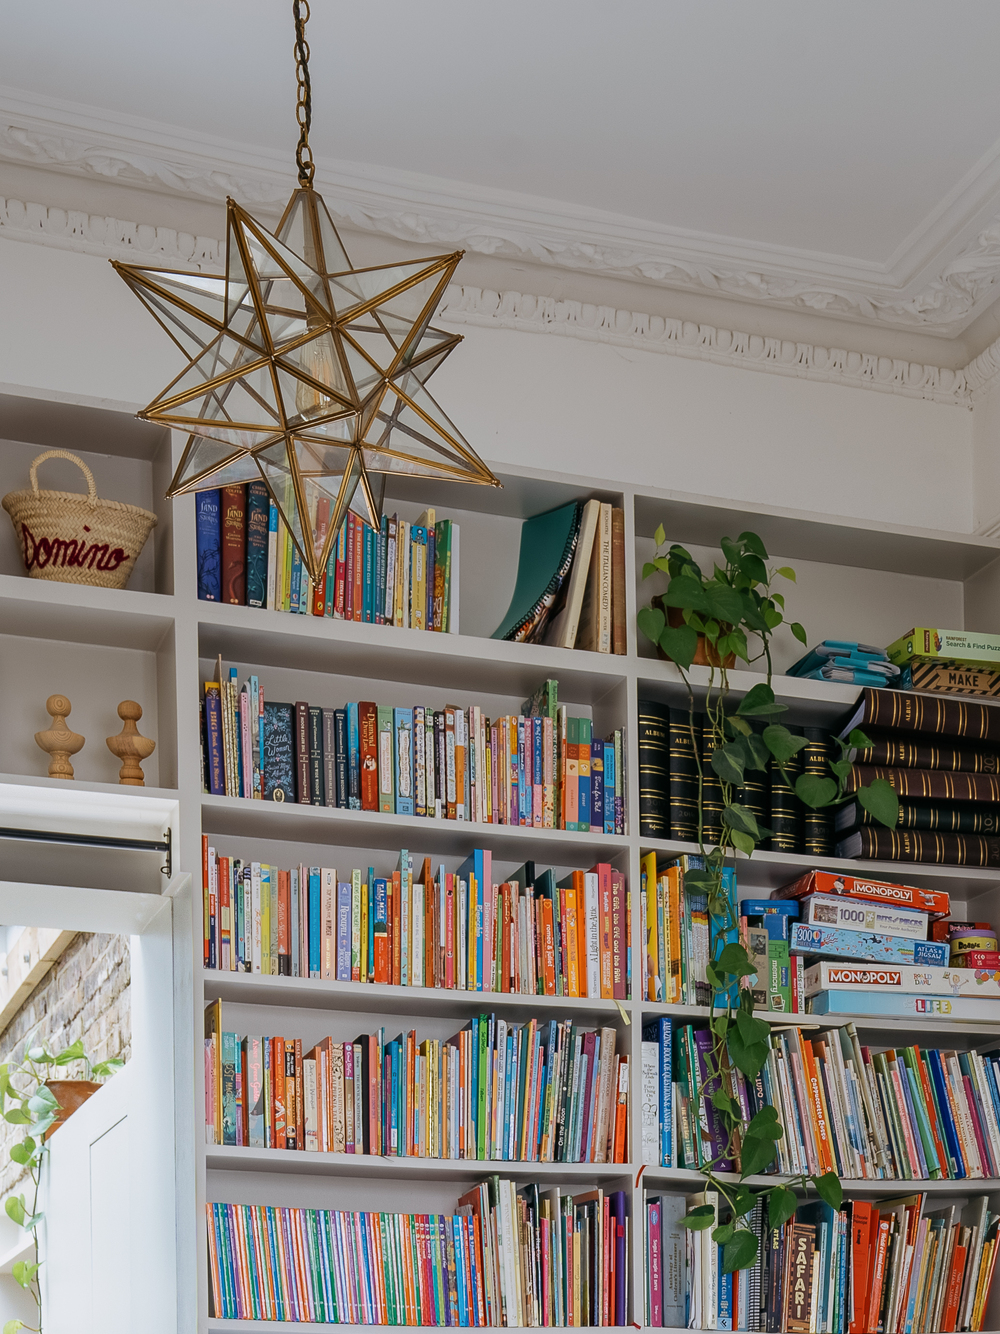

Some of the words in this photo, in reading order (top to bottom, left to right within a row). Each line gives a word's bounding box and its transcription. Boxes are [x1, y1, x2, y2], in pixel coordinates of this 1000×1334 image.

[22, 523, 129, 571] Domino
[948, 672, 979, 687] MAKE
[367, 713, 375, 747] Diamond
[645, 729, 665, 738] ALBUM
[376, 883, 384, 901] Tabby
[855, 883, 911, 900] MONOPOLY
[840, 908, 865, 923] 1000
[797, 928, 813, 942] 300
[917, 946, 937, 954] ATLAS
[770, 960, 778, 992] memory
[830, 970, 901, 985] MONOPOLY
[916, 999, 951, 1013] LIFE
[224, 1060, 235, 1081] LOST
[250, 1063, 260, 1081] Green
[250, 1082, 260, 1102] Gables
[662, 1072, 671, 1100] QUESTIONS
[755, 1078, 763, 1098] LUPO
[810, 1078, 823, 1119] Cappuccetto
[818, 1120, 827, 1140] Rosso
[664, 1108, 672, 1132] ANSWERS
[712, 1113, 720, 1133] Mago
[557, 1137, 563, 1146] On
[794, 1237, 808, 1319] SAFARI
